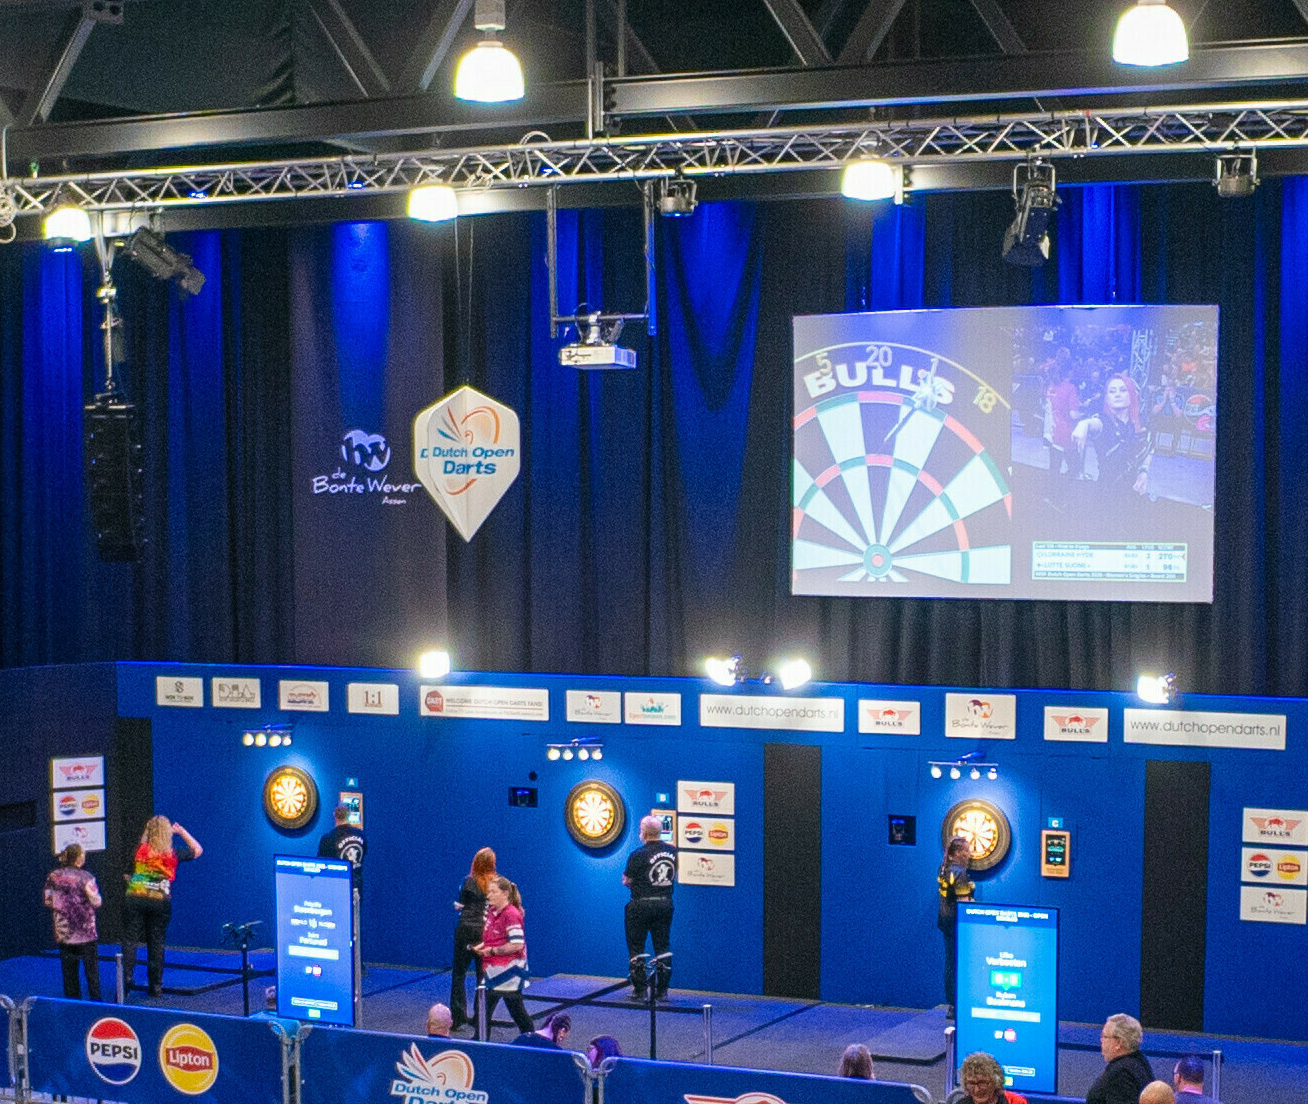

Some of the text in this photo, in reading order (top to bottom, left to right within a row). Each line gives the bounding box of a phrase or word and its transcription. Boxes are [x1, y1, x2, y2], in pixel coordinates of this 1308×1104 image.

[815, 352, 832, 376] 5
[866, 345, 892, 368] 20
[433, 447, 468, 458] Dutch
[472, 447, 514, 461] Open
[332, 467, 346, 480] de
[443, 460, 496, 475] Darts
[312, 474, 422, 494] Bonte Wever
[381, 496, 407, 505] Assen
[706, 704, 838, 721] www.dutchopendarts.nl
[1130, 718, 1281, 737] www.dutchopendarts.nl
[1051, 819, 1058, 828] C
[90, 1041, 137, 1060] PEPSI
[169, 1050, 210, 1066] Lipton
[394, 1083, 486, 1102] Dutch Open
